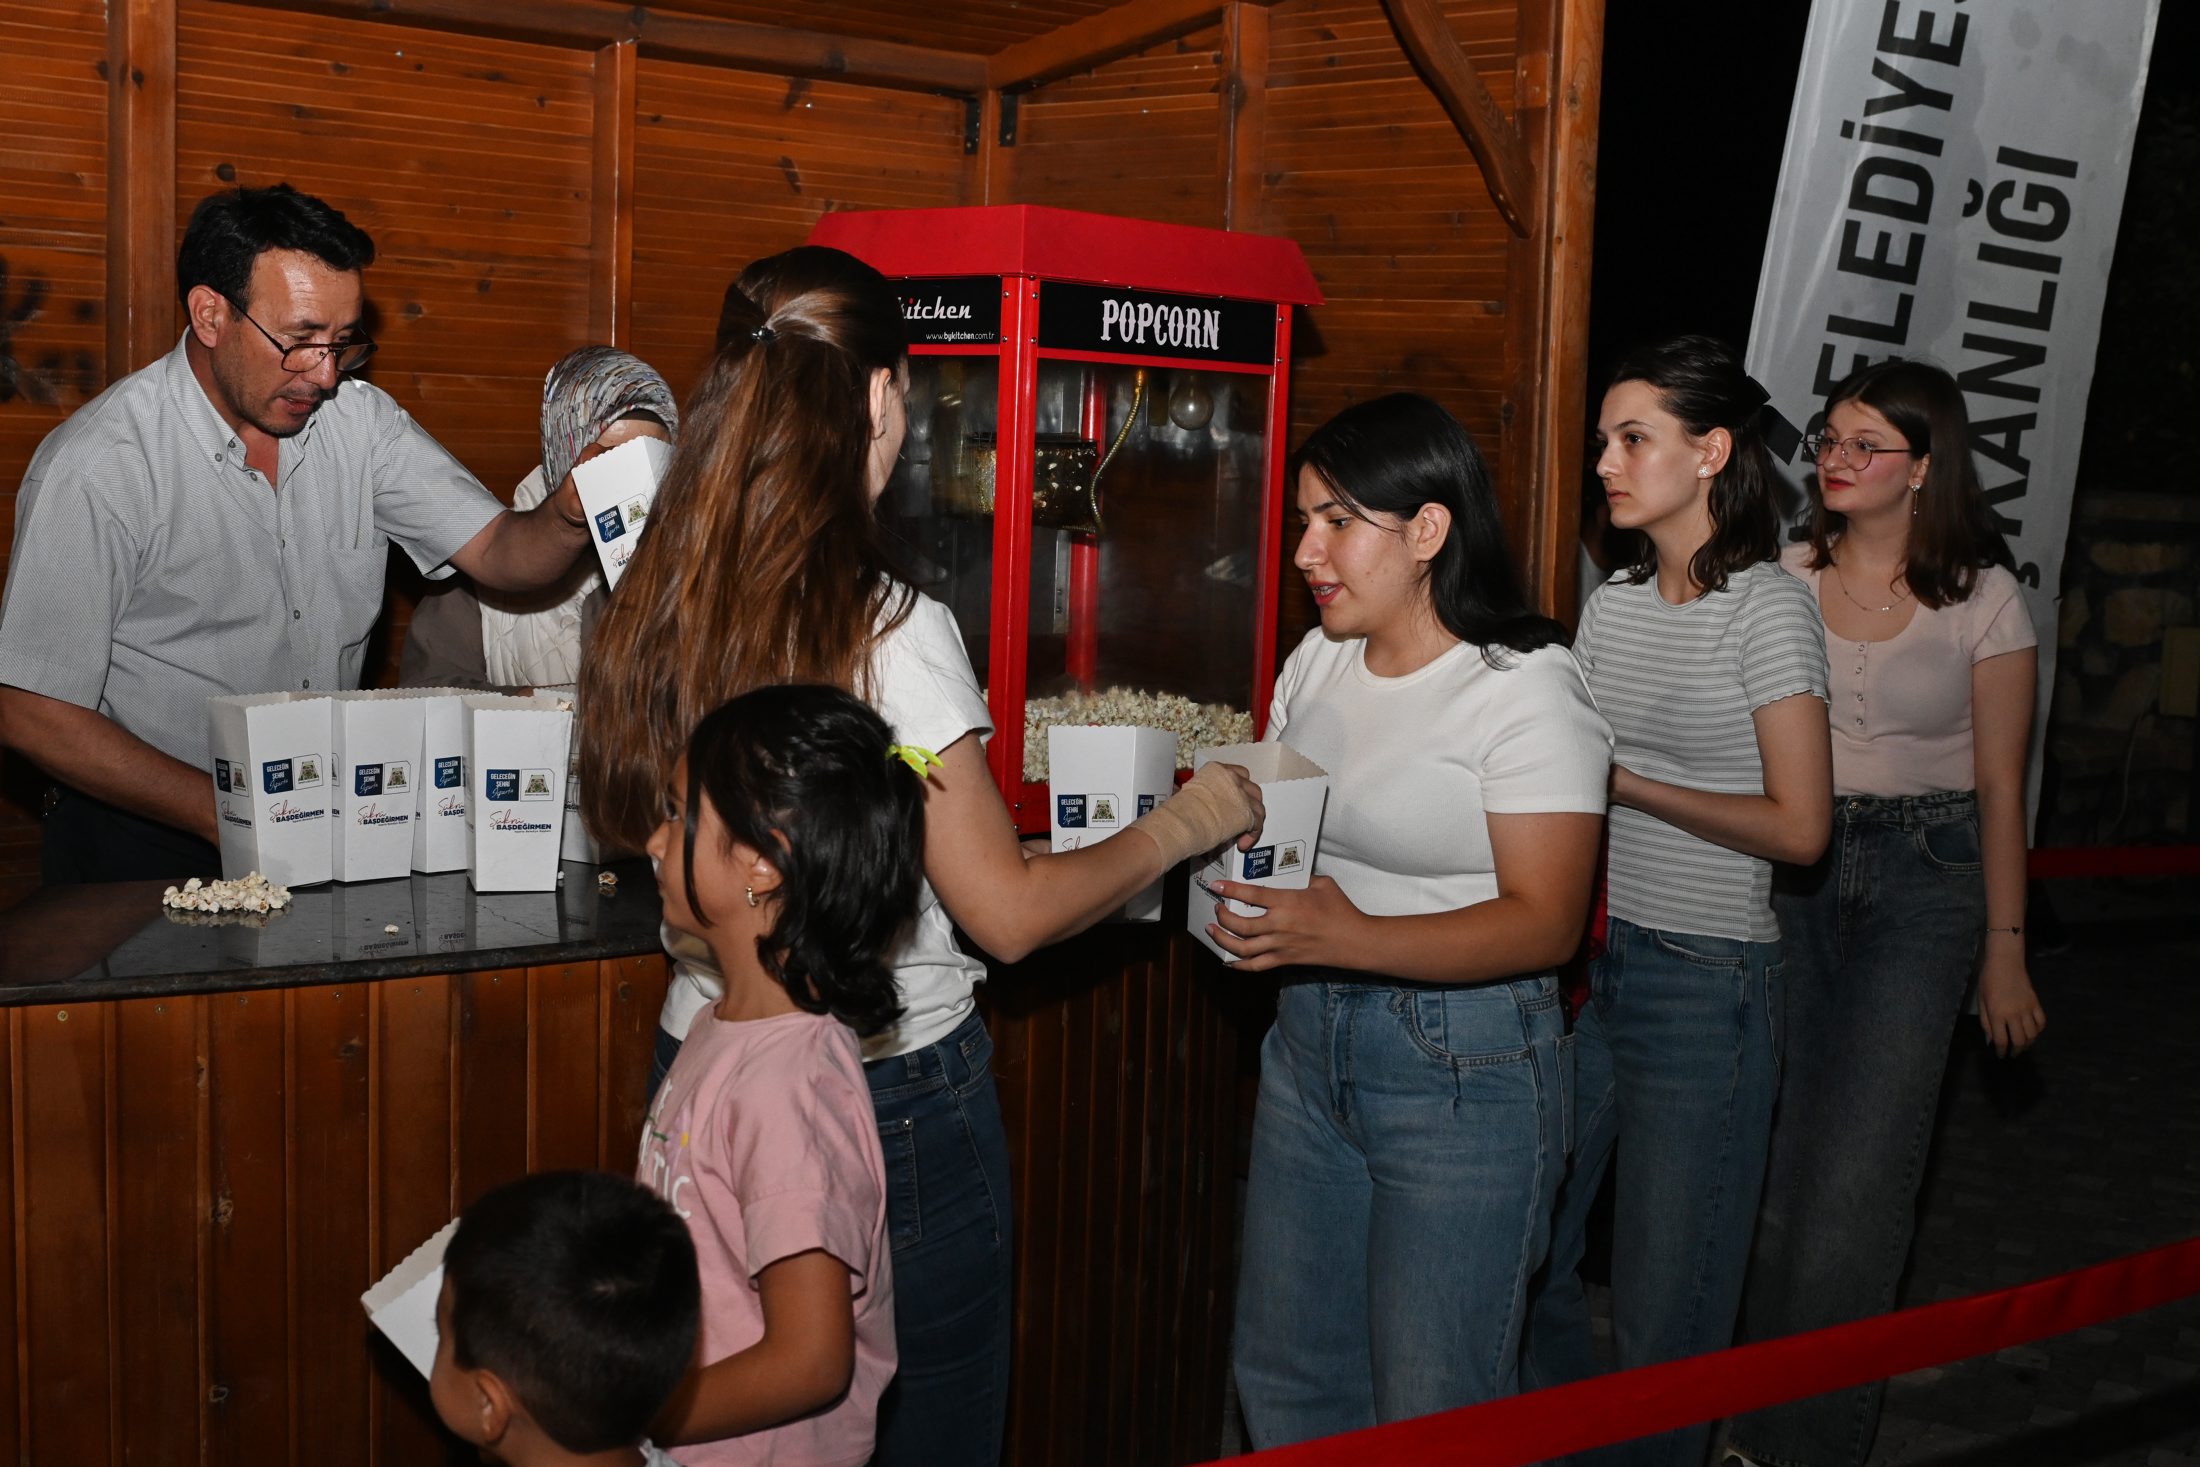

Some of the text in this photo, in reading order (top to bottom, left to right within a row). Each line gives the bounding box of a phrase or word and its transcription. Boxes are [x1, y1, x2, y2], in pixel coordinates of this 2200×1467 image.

[1100, 299, 1221, 350] POPCORN
[926, 332, 995, 342] www.bykitchen.com.tr
[275, 808, 325, 823] BAŞDEĞİRMEN
[362, 814, 409, 825] BAŞDEĞİRMEN
[496, 822, 552, 831] BAŞDEĞİRMEN
